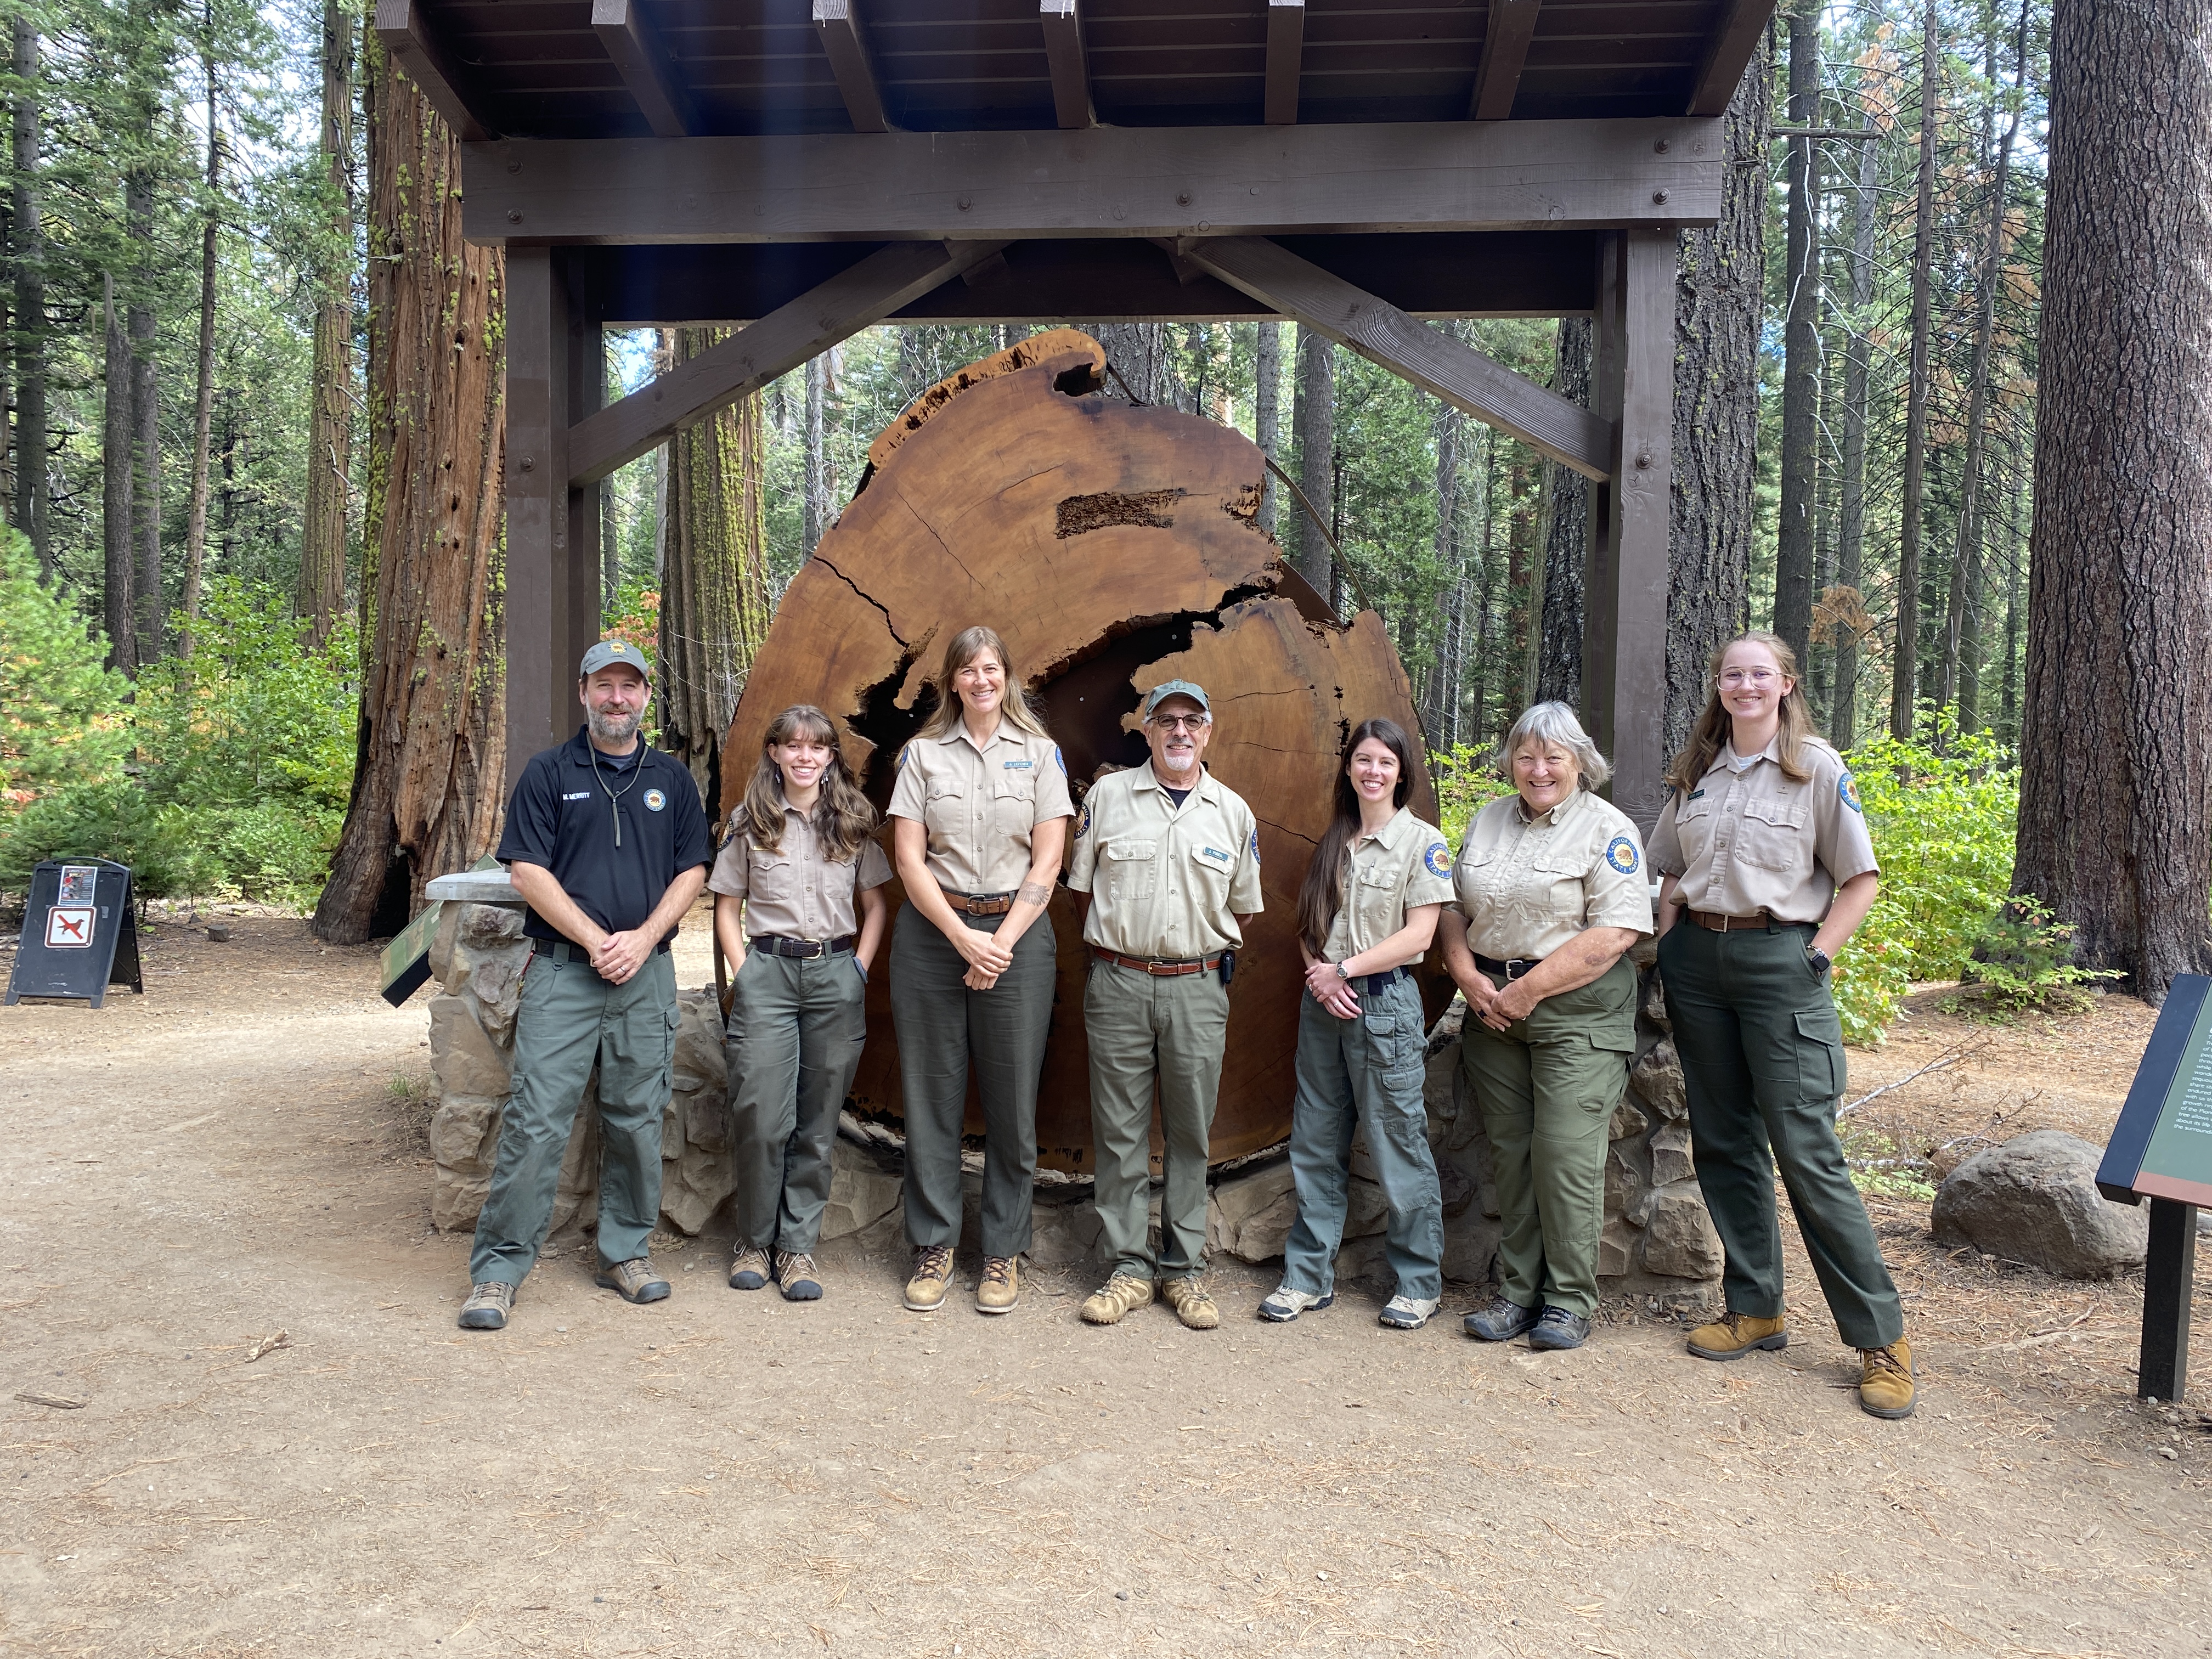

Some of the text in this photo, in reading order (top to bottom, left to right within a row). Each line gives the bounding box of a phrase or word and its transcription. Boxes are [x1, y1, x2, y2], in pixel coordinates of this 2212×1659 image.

[569, 792, 590, 800] MERRITT
[1608, 838, 1635, 853] CALIFORNIA
[1609, 856, 1638, 872] STATE PARKS
